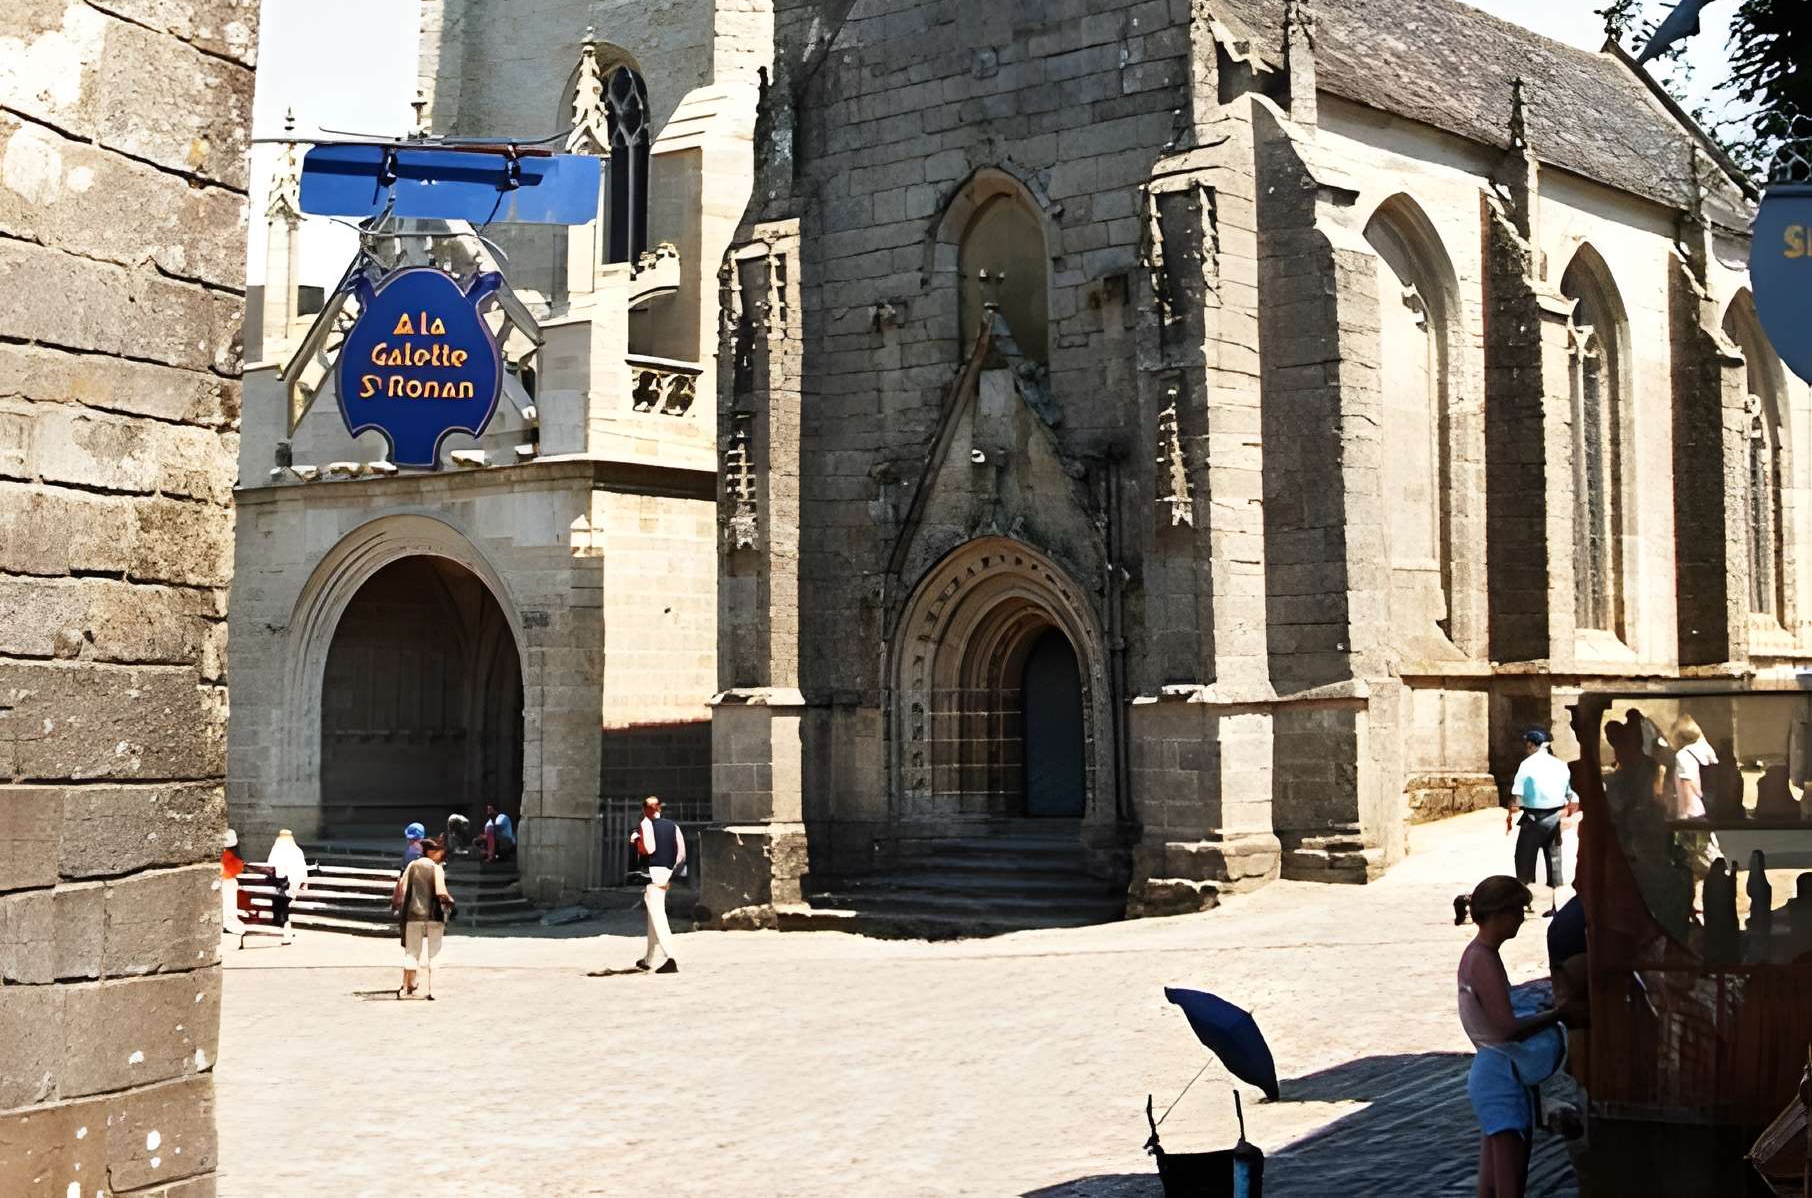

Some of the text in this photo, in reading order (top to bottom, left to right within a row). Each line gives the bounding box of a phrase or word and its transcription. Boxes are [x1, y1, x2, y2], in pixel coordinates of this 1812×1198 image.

[392, 311, 446, 335] A la
[387, 375, 474, 398] Ronan
